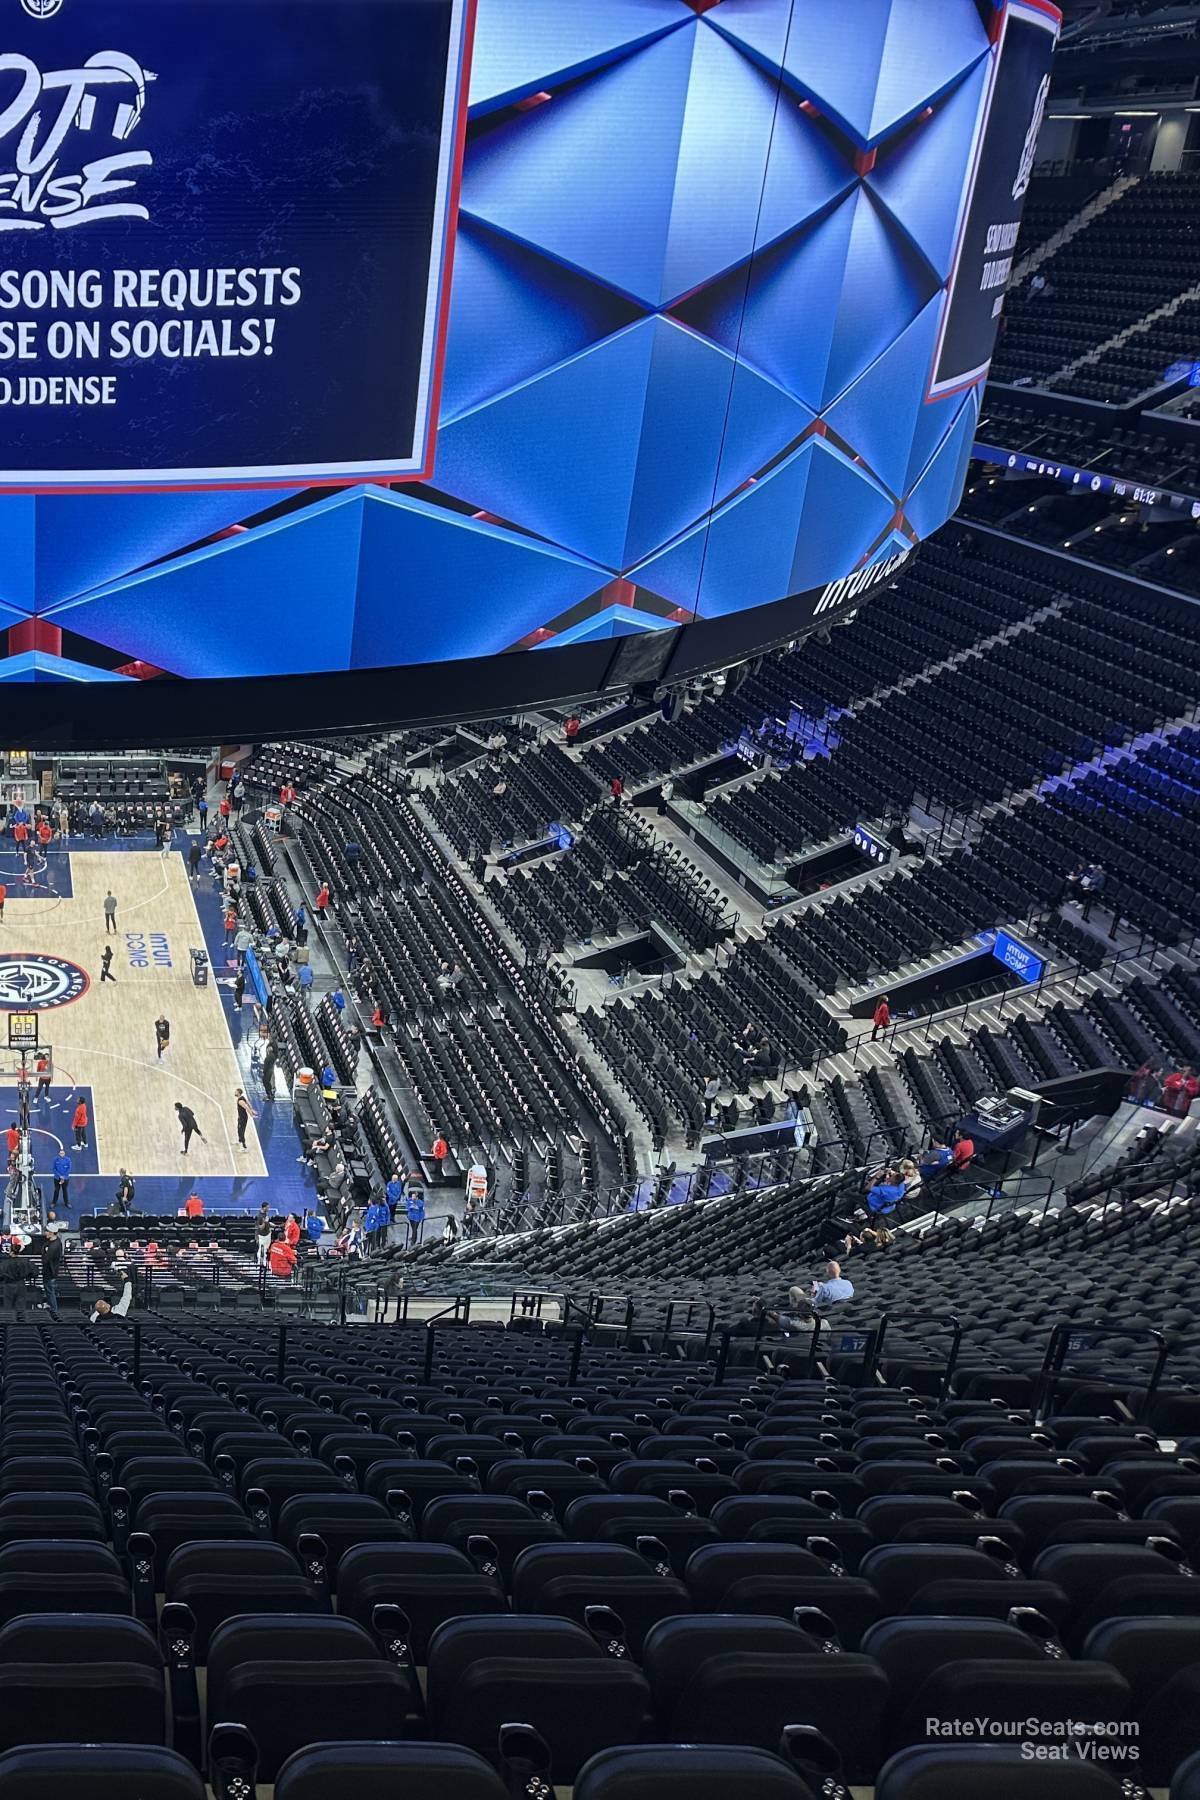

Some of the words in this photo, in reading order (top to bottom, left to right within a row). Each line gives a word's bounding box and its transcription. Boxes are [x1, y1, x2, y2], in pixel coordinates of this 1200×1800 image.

[0, 269, 103, 309] SONG
[113, 267, 301, 309] REQUESTS
[48, 320, 99, 359] ON
[109, 318, 275, 358] SOCIALS!
[1133, 487, 1156, 505] 61:12
[37, 956, 69, 969] LOS
[39, 971, 83, 1008] ANGELES
